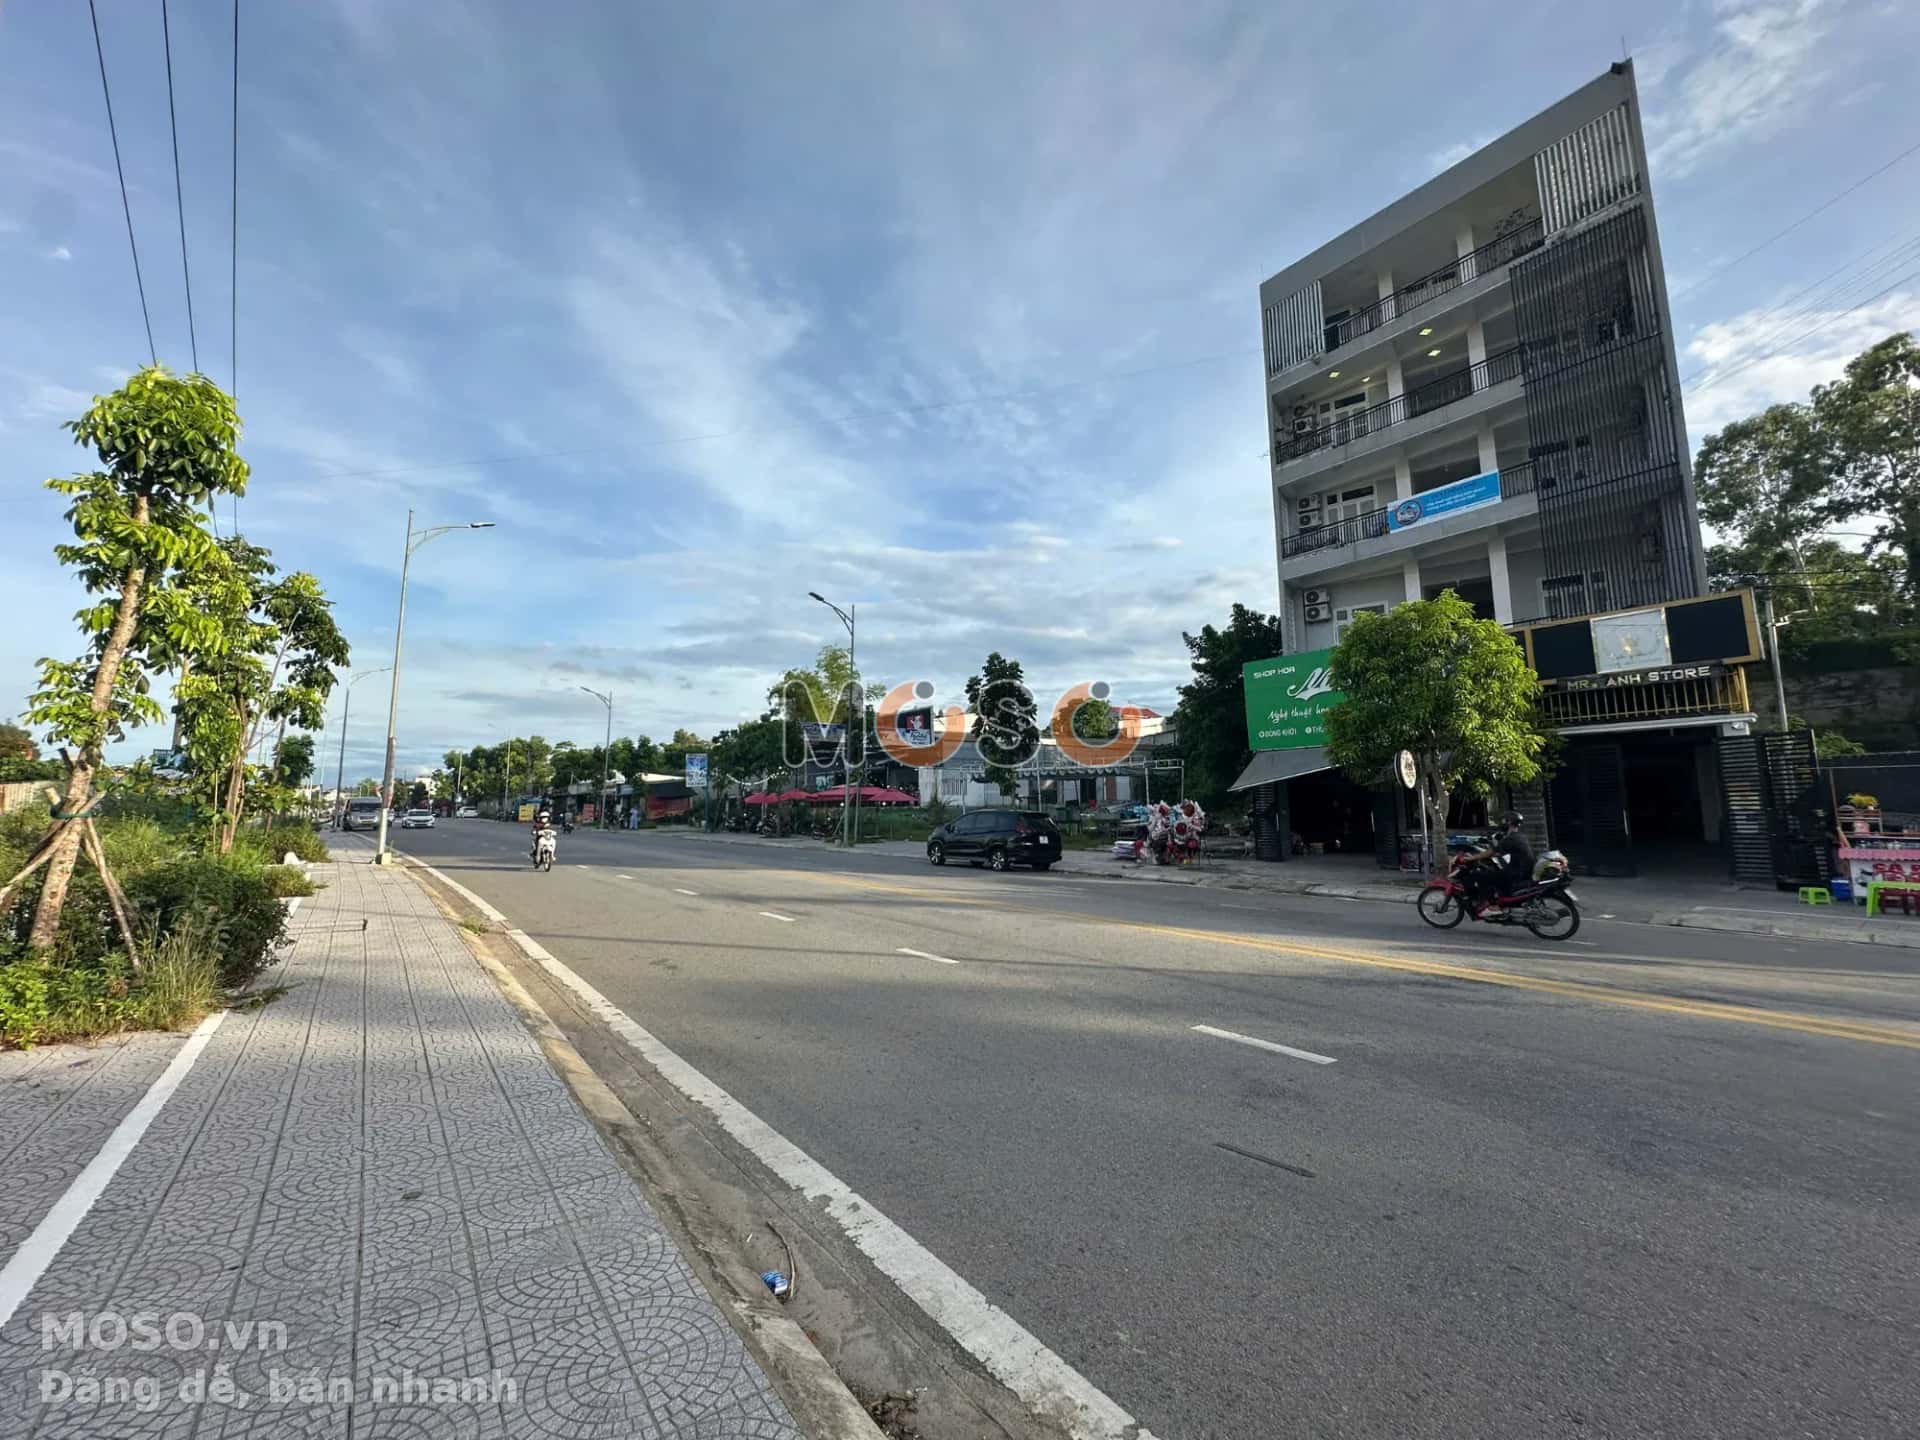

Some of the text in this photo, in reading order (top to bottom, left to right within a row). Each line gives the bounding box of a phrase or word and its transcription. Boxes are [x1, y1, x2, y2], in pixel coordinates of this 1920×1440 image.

[1253, 670, 1276, 679] SHOP
[1606, 673, 1641, 687] ANH
[1648, 666, 1712, 682] STORE
